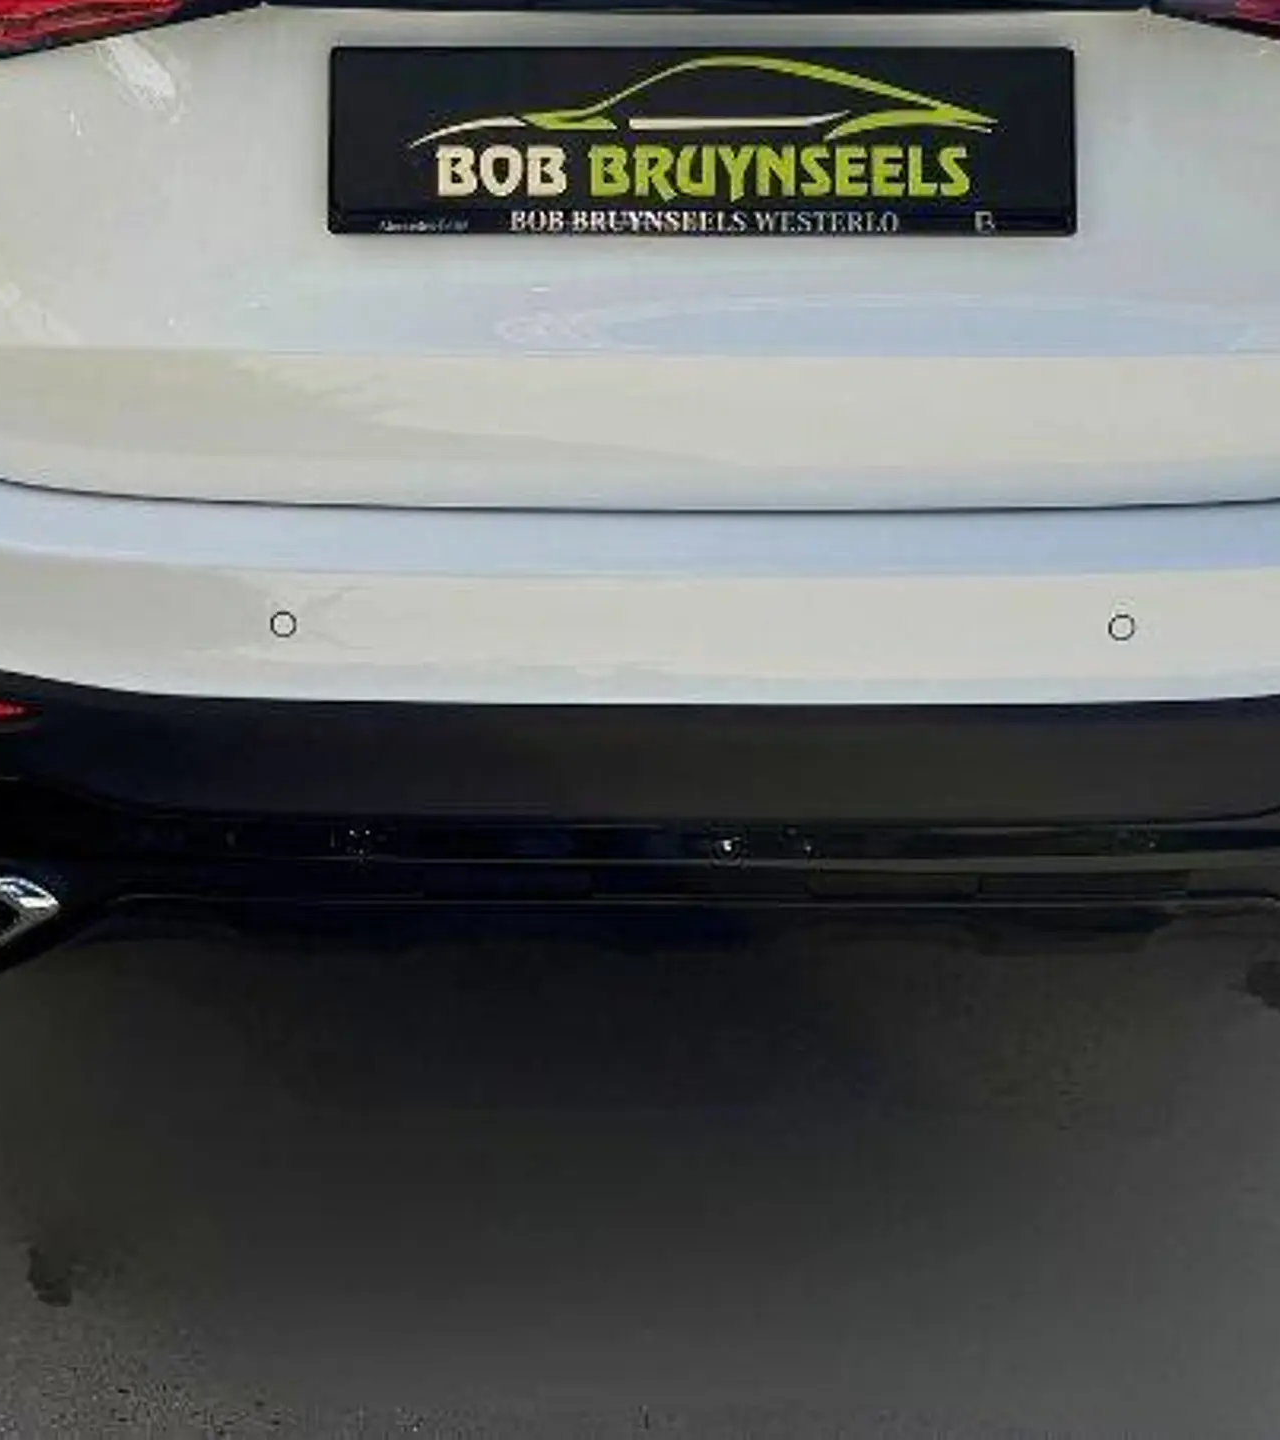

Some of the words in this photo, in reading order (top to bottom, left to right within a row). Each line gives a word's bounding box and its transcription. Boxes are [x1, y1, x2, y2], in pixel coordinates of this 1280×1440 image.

[436, 145, 567, 197] BOB
[588, 145, 972, 201] BRUYNSEELS
[508, 210, 565, 233] BOB
[571, 210, 748, 233] BRUYNSEELS
[753, 210, 900, 233] WESTERLO
